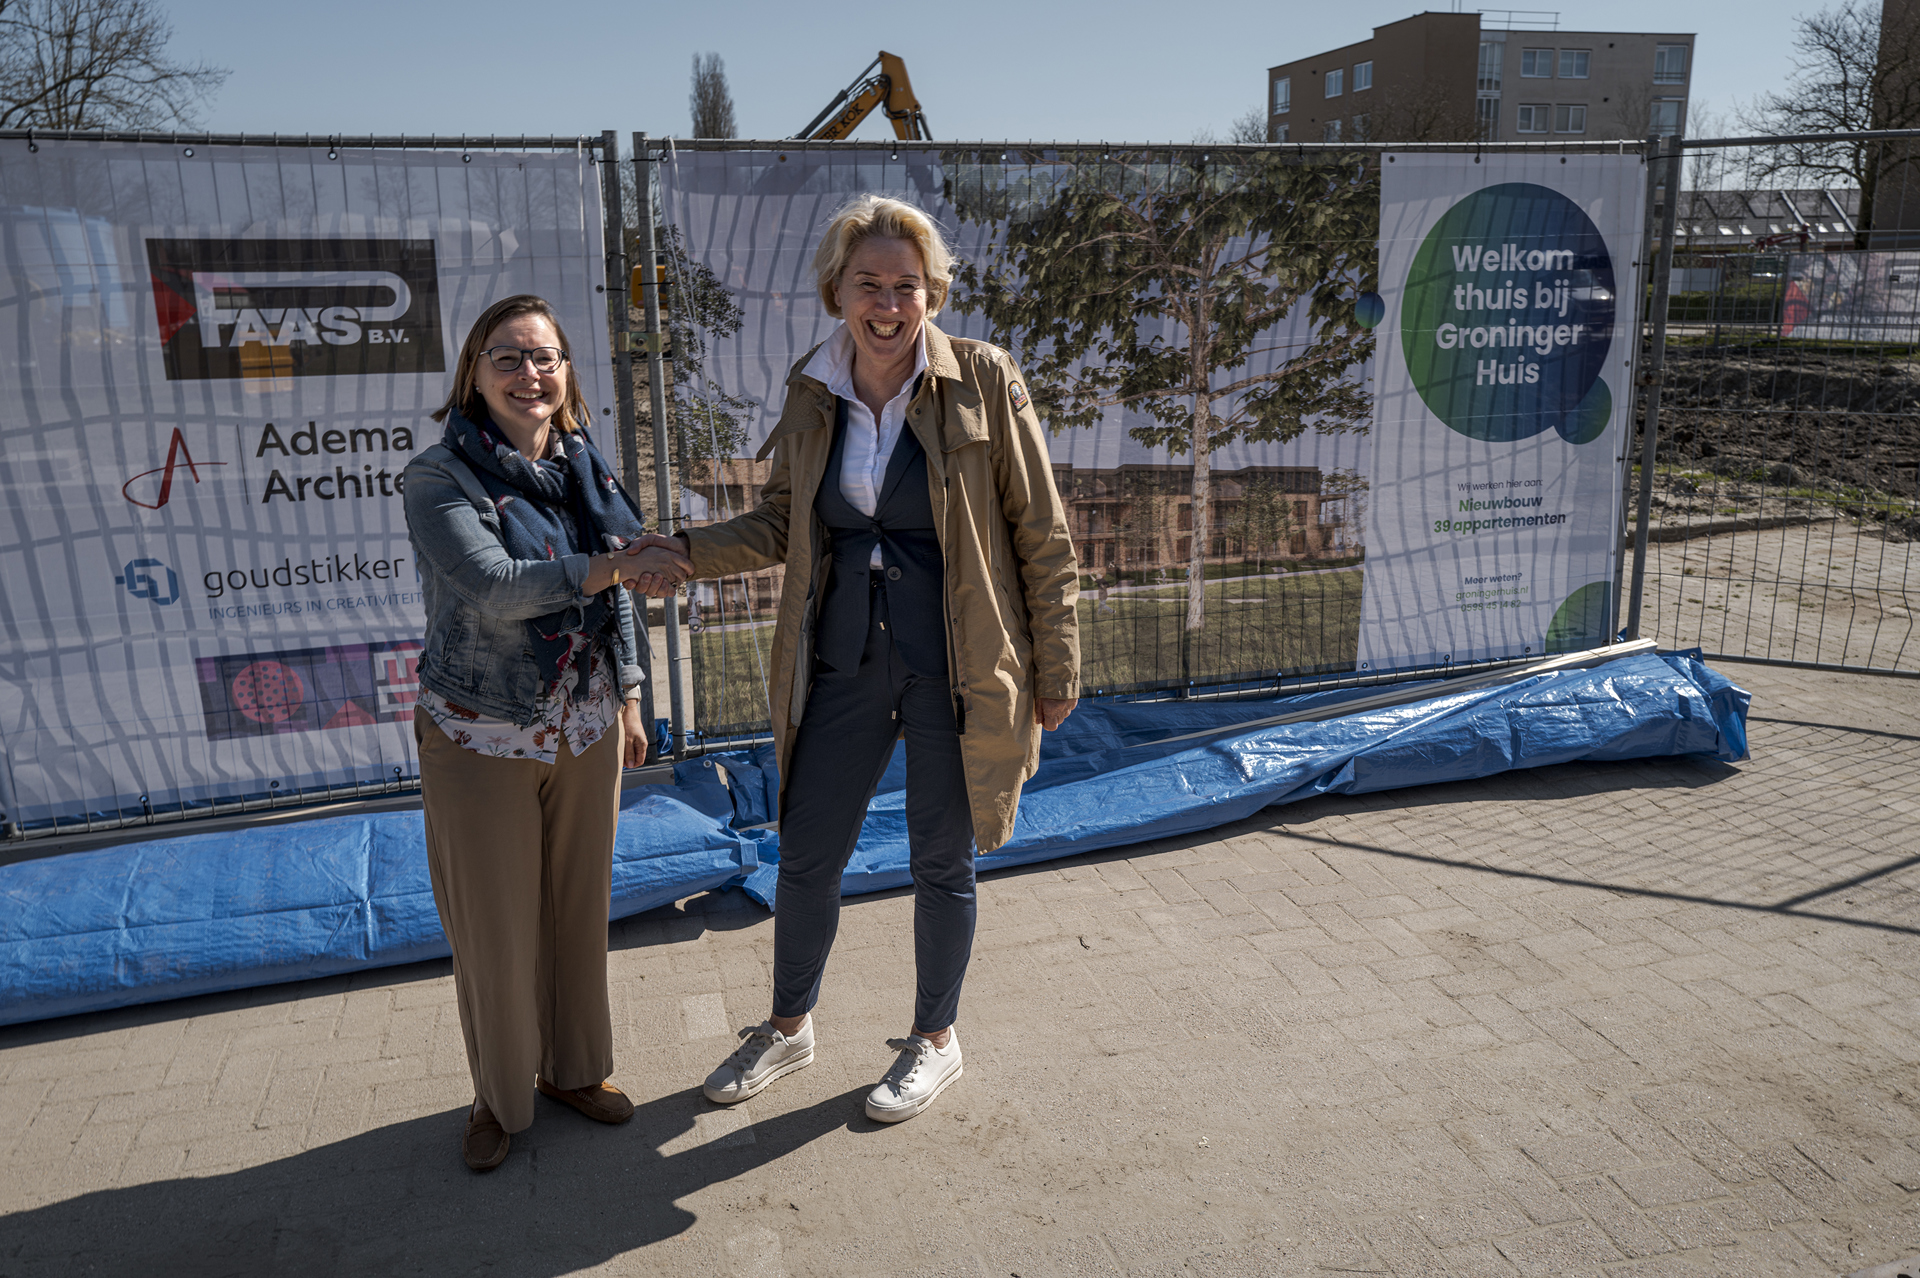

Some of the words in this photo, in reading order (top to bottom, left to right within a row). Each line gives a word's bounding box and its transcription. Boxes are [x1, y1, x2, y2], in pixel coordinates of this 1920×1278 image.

[840, 103, 864, 128] KOK
[1451, 244, 1574, 272] Welkom
[1453, 280, 1528, 311] thuis
[1534, 279, 1569, 317] bij
[368, 329, 410, 344] B.V.
[1436, 318, 1583, 355] Groninger
[1476, 355, 1540, 385] Huis
[256, 421, 413, 457] Adema
[1457, 482, 1471, 493] Wij
[1472, 481, 1504, 491] werken
[1506, 479, 1522, 488] hier
[1524, 479, 1543, 487] aan:
[1458, 496, 1543, 512] Nieuwbouw
[1434, 519, 1451, 533] 39
[1453, 513, 1566, 535] appartementen
[203, 553, 405, 598] goudstikker
[1464, 576, 1488, 585] Meer
[1489, 573, 1522, 583] weten?
[209, 602, 302, 620] INGENIEURS
[307, 599, 322, 612] IN
[326, 592, 423, 611] CREATIVITEIT
[1455, 586, 1529, 601] groningerhuis.nl
[1486, 601, 1497, 610] 45
[1499, 600, 1508, 609] 14
